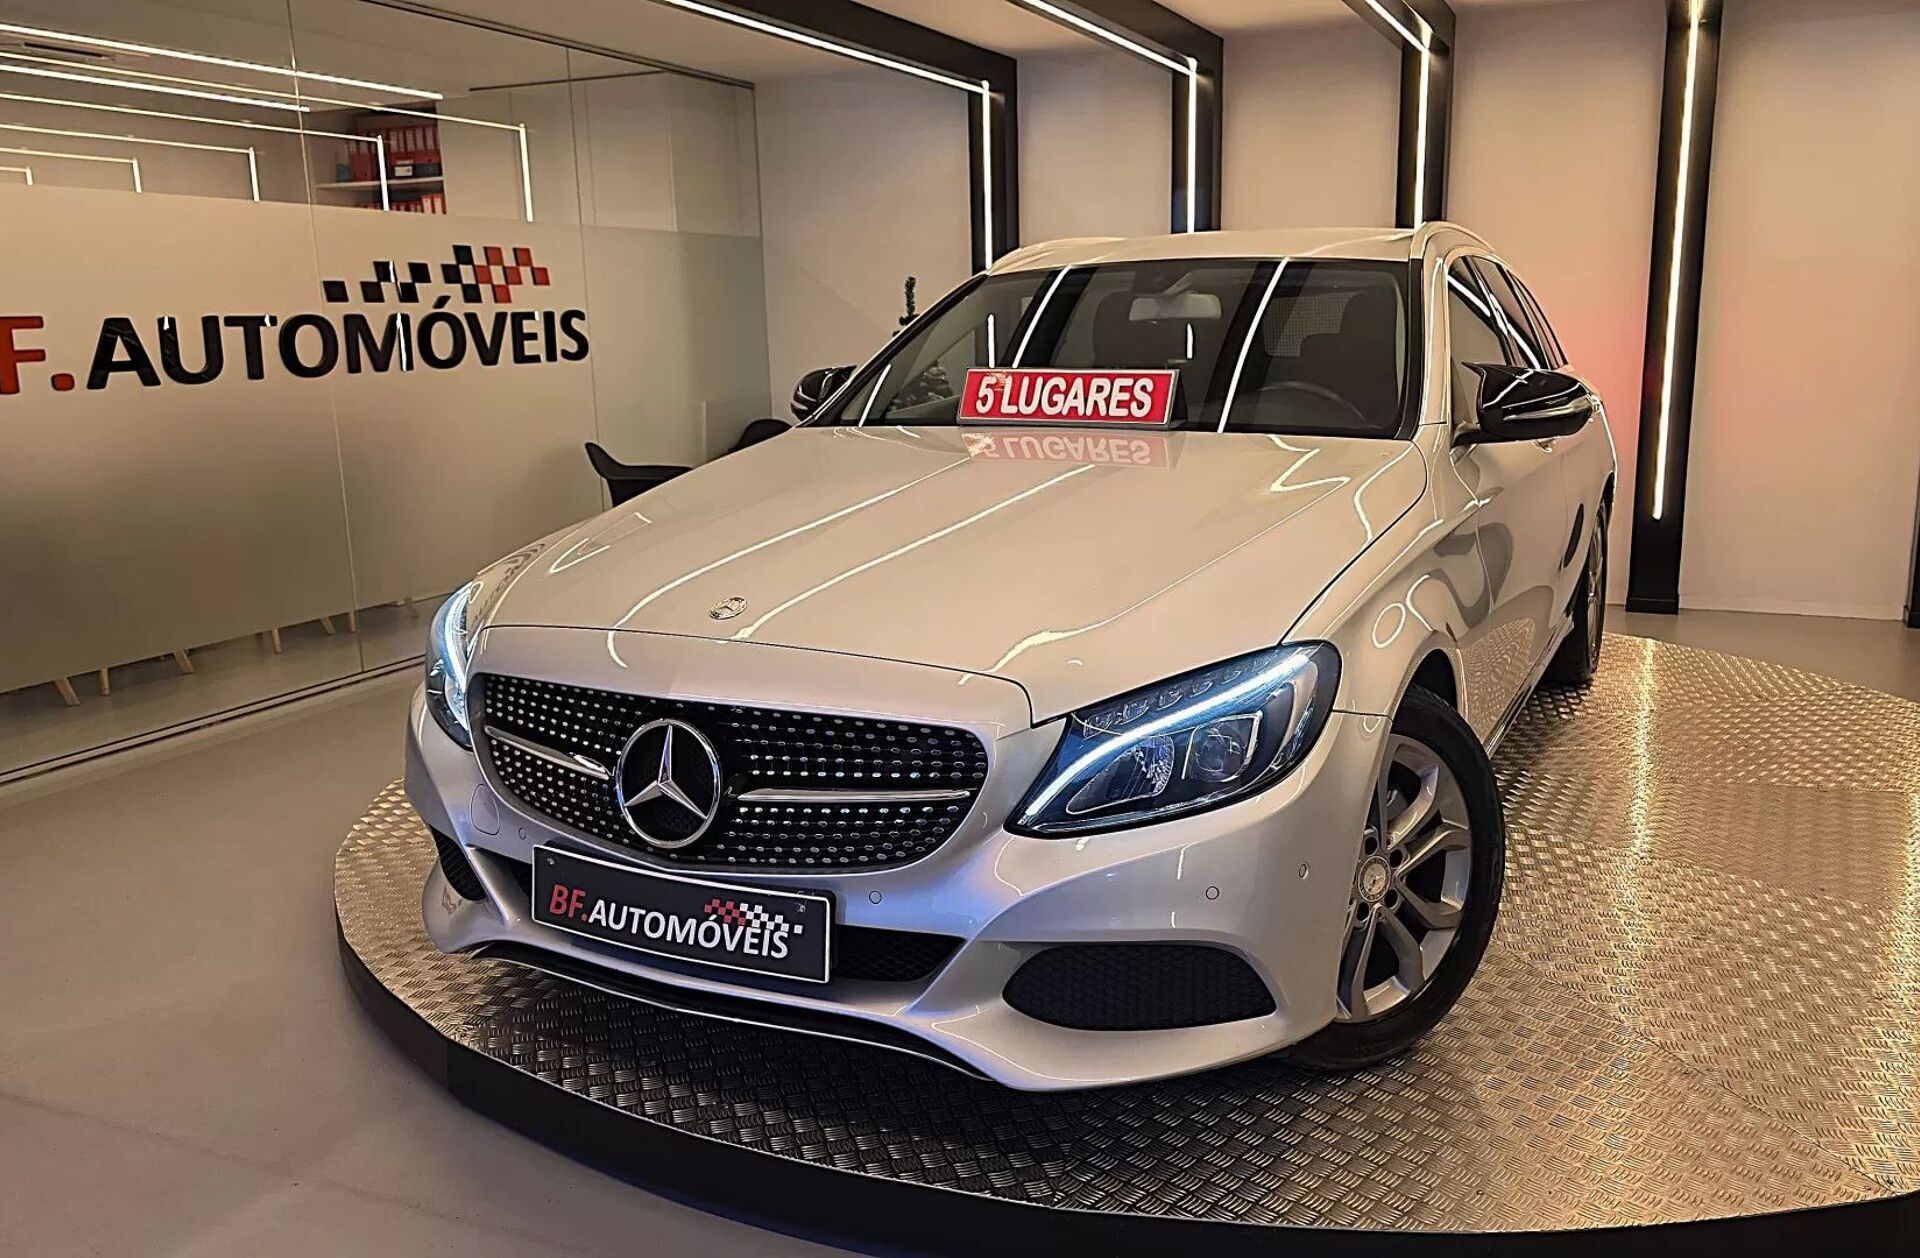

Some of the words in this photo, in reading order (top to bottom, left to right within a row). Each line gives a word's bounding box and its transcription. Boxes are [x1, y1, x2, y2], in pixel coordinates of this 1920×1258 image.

[976, 376, 997, 413] 5
[1000, 375, 1154, 418] LUGARES
[549, 884, 789, 959] BF.AUTOMÓVEIS
